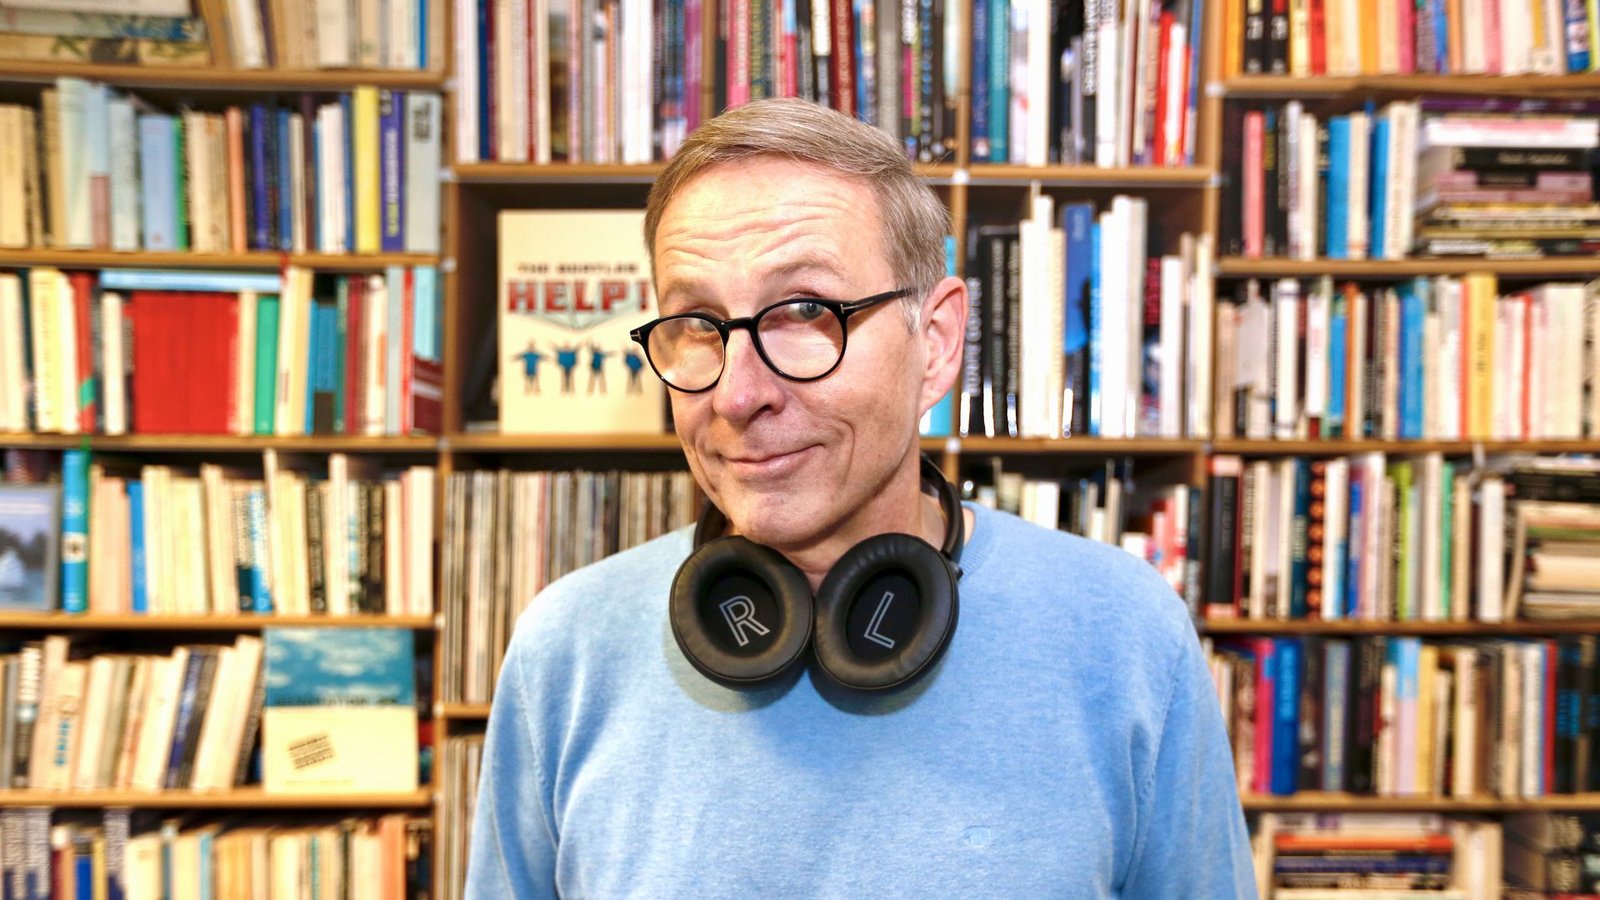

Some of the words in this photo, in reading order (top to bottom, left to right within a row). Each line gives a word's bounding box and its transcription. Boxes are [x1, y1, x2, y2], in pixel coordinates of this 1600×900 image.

[508, 280, 649, 313] HELP!
[719, 595, 770, 647] R
[864, 591, 895, 649] L
